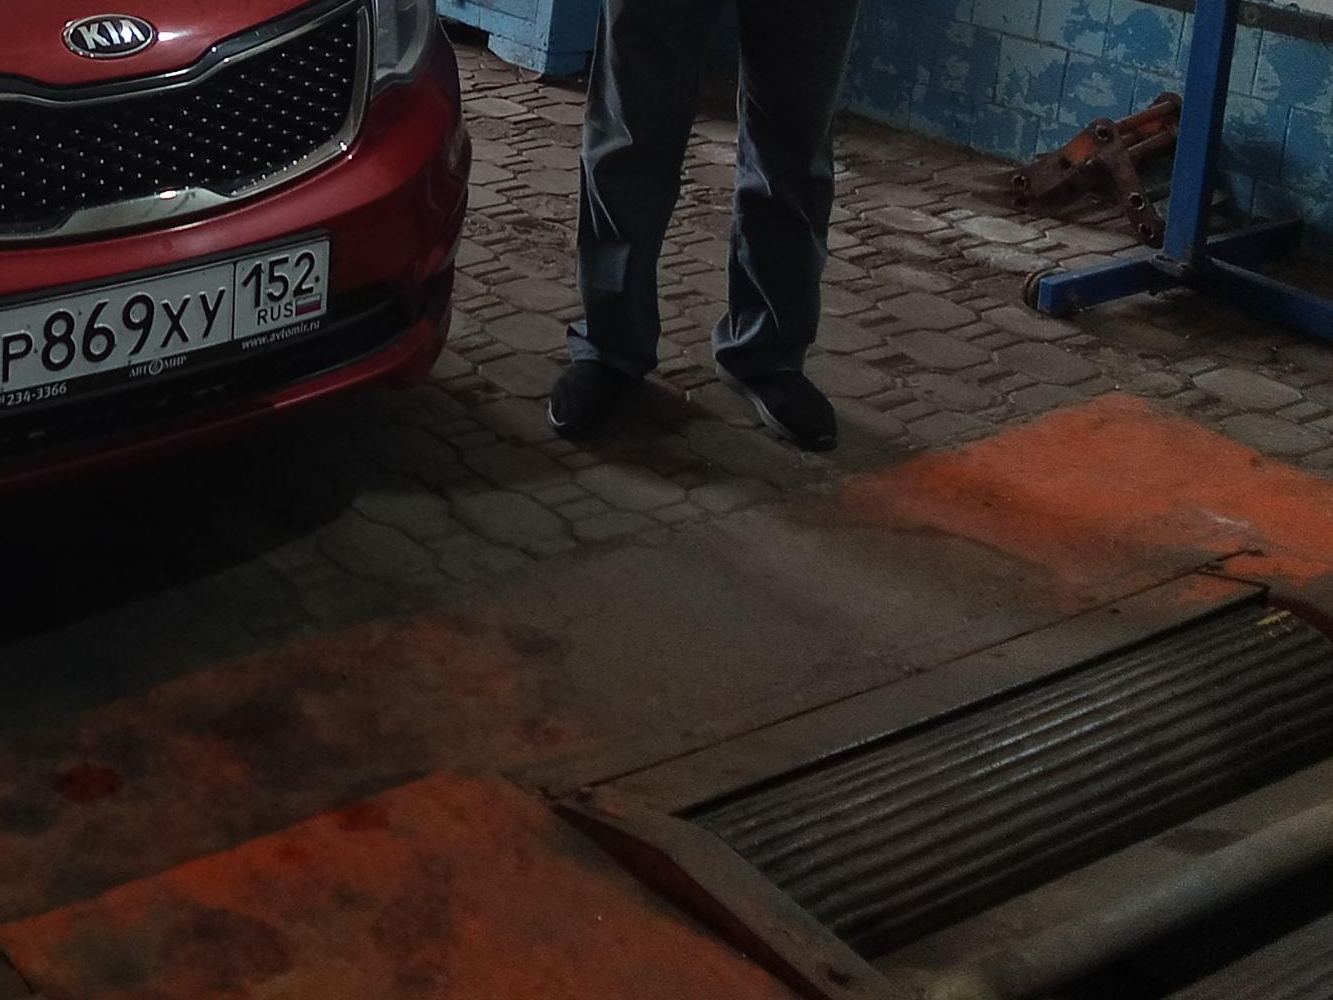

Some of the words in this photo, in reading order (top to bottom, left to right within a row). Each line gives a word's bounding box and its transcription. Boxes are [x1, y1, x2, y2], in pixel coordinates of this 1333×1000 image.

[77, 19, 146, 50] KIA
[242, 251, 316, 308] 152
[257, 302, 294, 326] RUS
